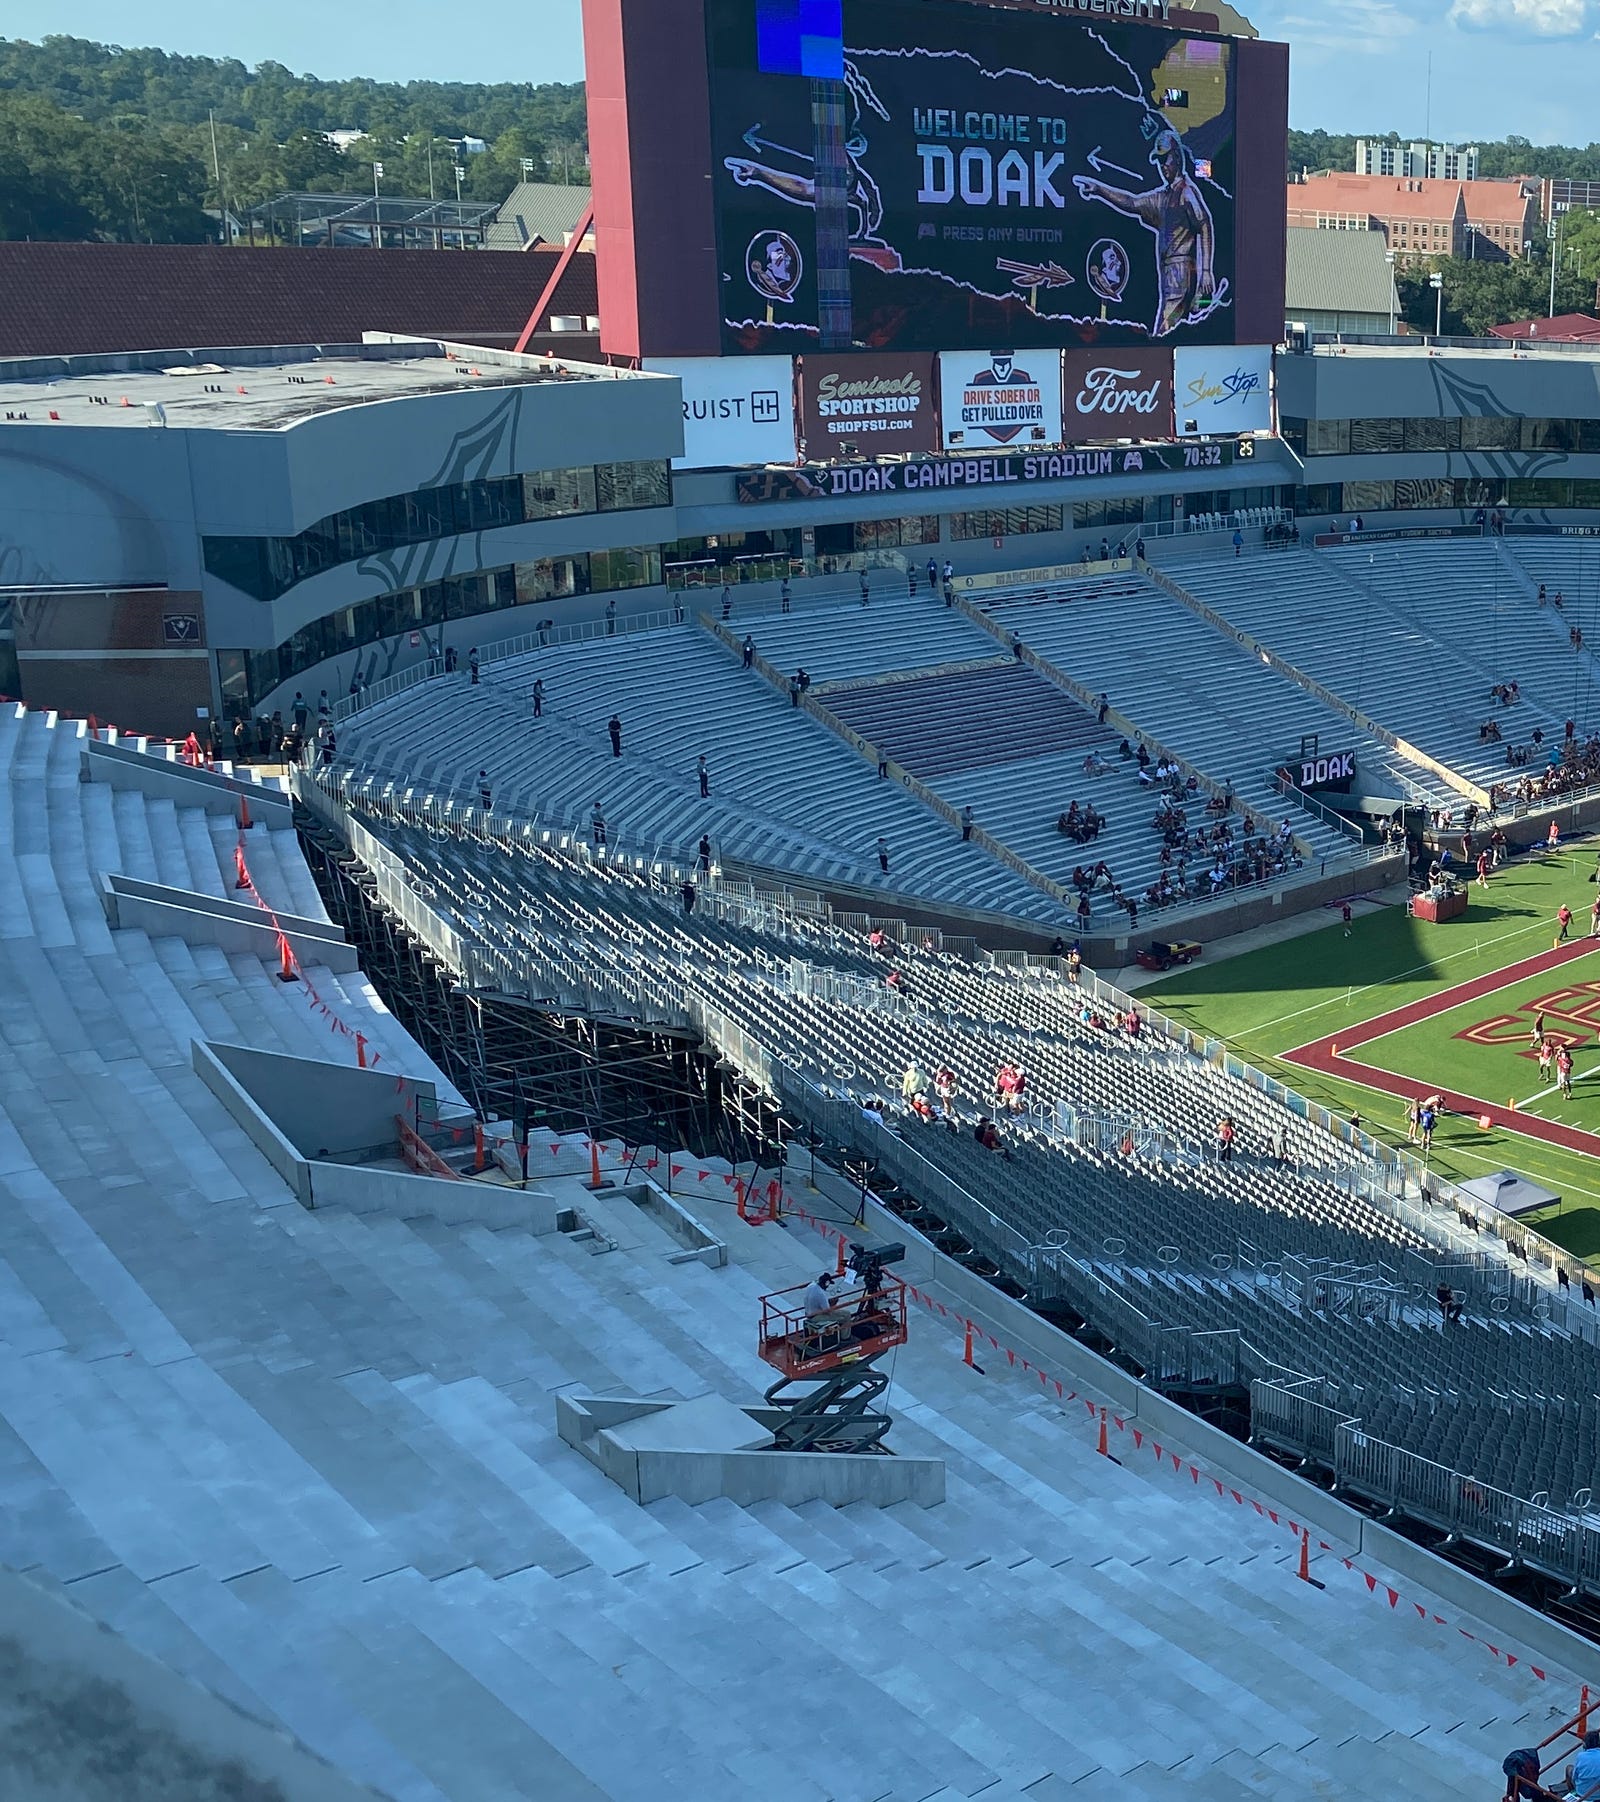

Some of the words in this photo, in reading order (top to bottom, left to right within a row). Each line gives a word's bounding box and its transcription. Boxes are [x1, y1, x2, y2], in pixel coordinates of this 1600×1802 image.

[1035, 0, 1169, 20] ERSITY
[913, 107, 1030, 143] WELCOME
[1037, 116, 1067, 145] TO
[916, 143, 1065, 208] DOAK
[943, 225, 984, 241] PRESS
[988, 227, 1013, 241] ANY
[1016, 228, 1063, 243] BUTTON
[817, 371, 922, 401] Seminole
[1075, 367, 1161, 414] Ford
[819, 396, 920, 416] SPORTSHOP
[963, 389, 993, 405] DRIVE
[995, 388, 1026, 404] SOBER
[1028, 388, 1040, 403] OR
[682, 398, 745, 421] RUIST
[961, 407, 980, 422] GET
[982, 406, 1017, 421] PULLED
[1018, 405, 1043, 420] OVER
[827, 419, 913, 433] SHOPFSU.COM
[1183, 446, 1221, 466] 70:32
[1240, 441, 1252, 457] 25
[830, 465, 896, 494] DOAK
[904, 458, 1018, 488] CAMPBELL
[1024, 452, 1112, 479] STADIUM
[996, 569, 1050, 585] MARCHING
[1301, 752, 1354, 787] DOAK
